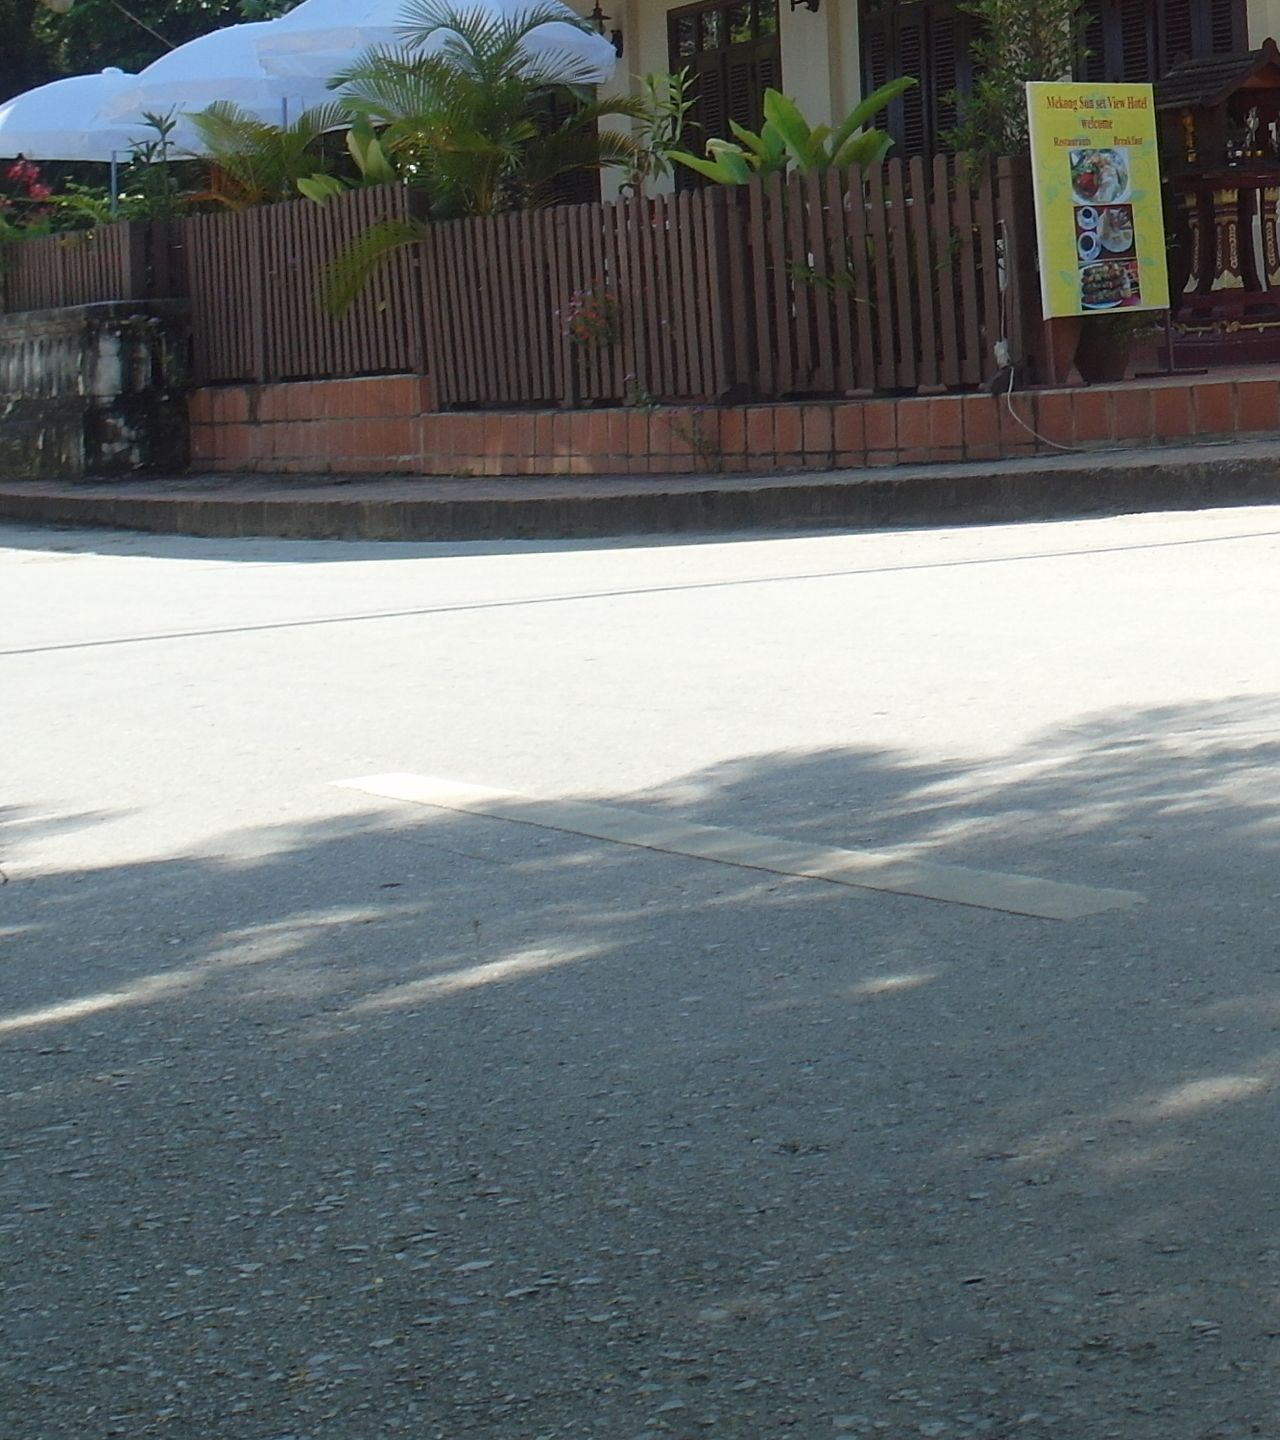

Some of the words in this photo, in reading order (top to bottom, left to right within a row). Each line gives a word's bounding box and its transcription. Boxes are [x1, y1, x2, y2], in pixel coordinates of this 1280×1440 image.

[1046, 95, 1078, 112] Mekong
[1106, 96, 1126, 109] View
[1127, 96, 1148, 110] Hotel
